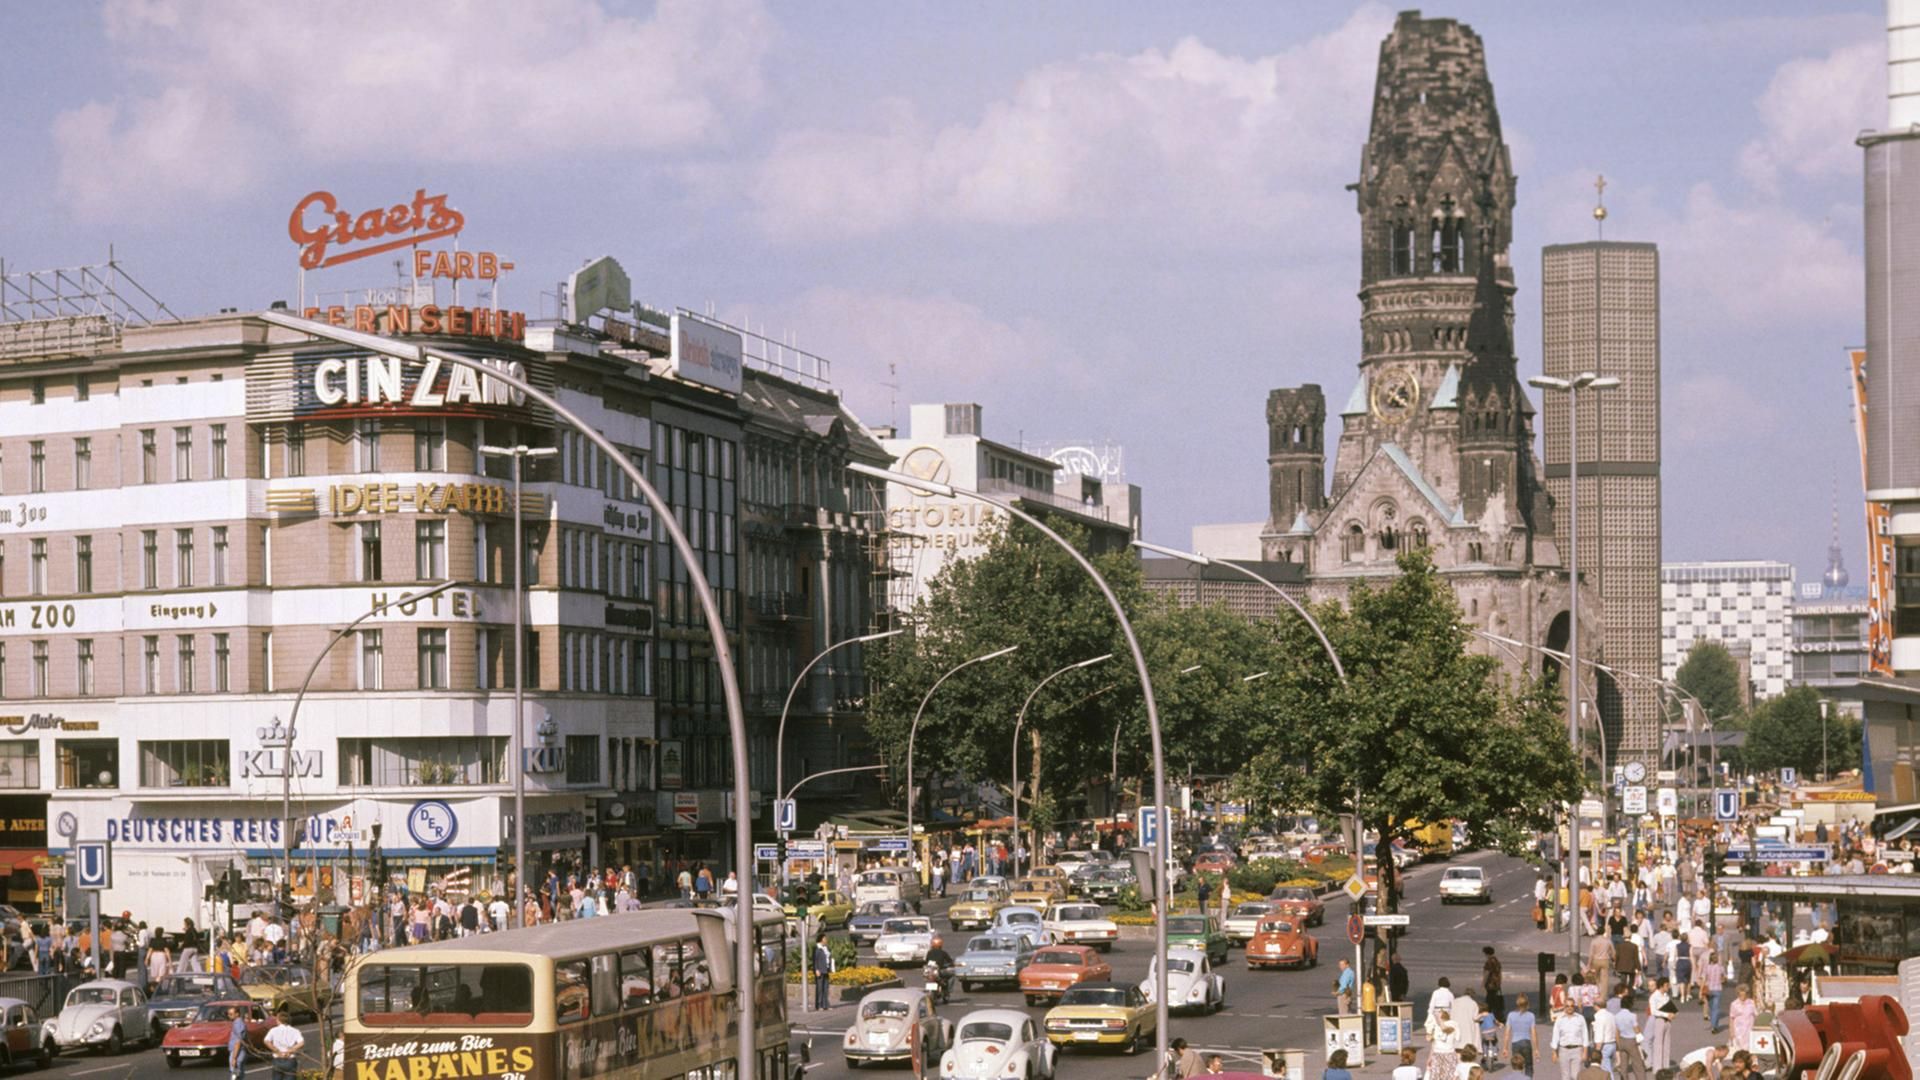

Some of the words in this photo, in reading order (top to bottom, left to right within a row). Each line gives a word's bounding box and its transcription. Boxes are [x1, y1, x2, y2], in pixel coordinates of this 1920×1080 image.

[414, 249, 515, 280] FARB-
[314, 355, 527, 407] CINZANO
[16, 502, 47, 528] Zoo
[31, 604, 76, 629] ZOO
[150, 604, 204, 620] Eingang
[371, 591, 482, 618] HOTEL
[239, 750, 323, 778] KLM
[526, 747, 566, 773] KLM
[1718, 794, 1735, 818] U
[107, 817, 222, 843] DEUTSCHES
[419, 808, 444, 838] DER
[80, 847, 103, 882] U
[363, 1041, 418, 1060] Bestell
[420, 1039, 459, 1054] zum
[460, 1034, 494, 1051] Bier
[356, 1046, 535, 1080] KABÄNES
